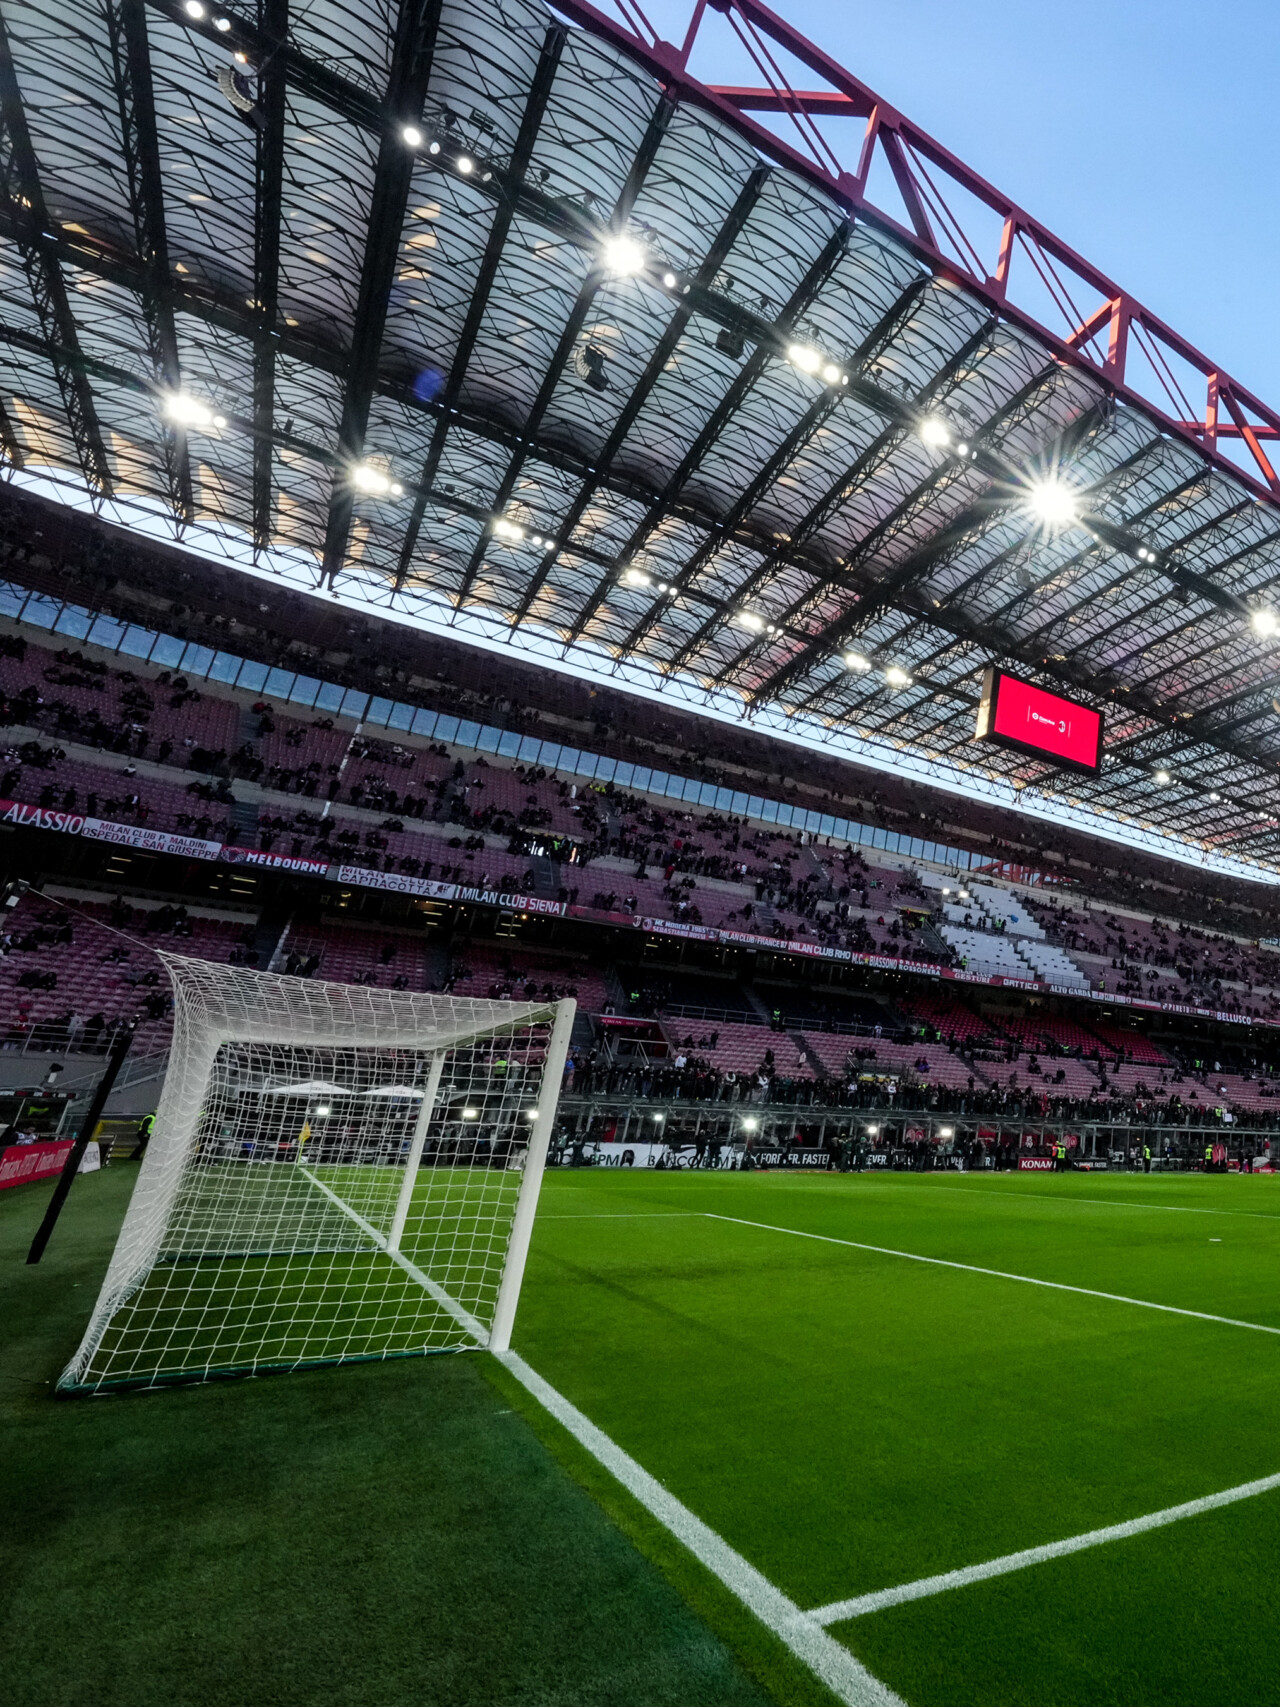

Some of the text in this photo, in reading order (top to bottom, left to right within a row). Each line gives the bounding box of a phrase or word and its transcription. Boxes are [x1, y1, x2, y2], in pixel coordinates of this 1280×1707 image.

[2, 803, 84, 834] ALASSIO
[82, 827, 219, 860] OSPEDALE SAN GIUSEPPE
[100, 822, 130, 835] MILAN
[132, 828, 157, 840] CLUB
[169, 836, 208, 849] MALDINI
[246, 852, 328, 875] MELBOURNE
[341, 866, 386, 879] MILAN
[340, 873, 431, 896] CAPRACOTTA
[460, 888, 560, 914] MILAN CLUB SIENA
[719, 930, 740, 941] MILAN
[788, 941, 851, 960] MILAN CLUB RHO
[899, 964, 941, 976] ROSSONERA
[1049, 984, 1092, 998] ALTO GARDA
[1217, 1011, 1252, 1025] BELLUSCO
